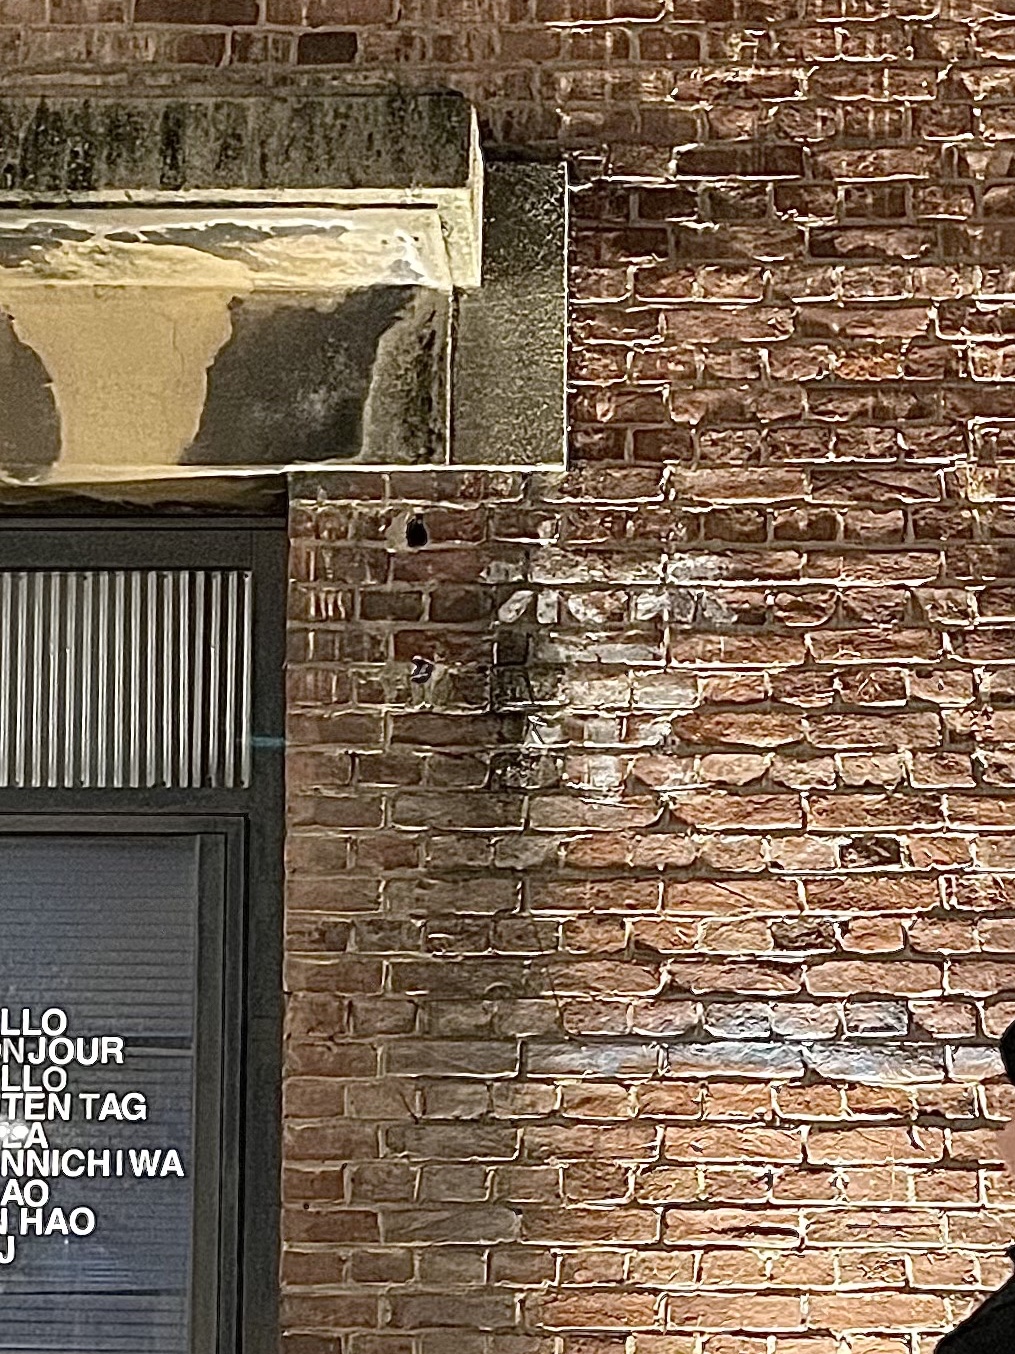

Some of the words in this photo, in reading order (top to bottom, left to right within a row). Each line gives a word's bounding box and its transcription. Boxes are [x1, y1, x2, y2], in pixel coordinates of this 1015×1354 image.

[1, 1008, 67, 1036] LLO
[0, 1036, 124, 1065] NJOUR
[1, 1065, 67, 1092] LLO
[1, 1093, 71, 1120] TEN
[79, 1092, 147, 1120] TAG
[1, 1149, 184, 1177] NNICHIWA
[1, 1179, 49, 1207] AO
[20, 1207, 95, 1236] HAO
